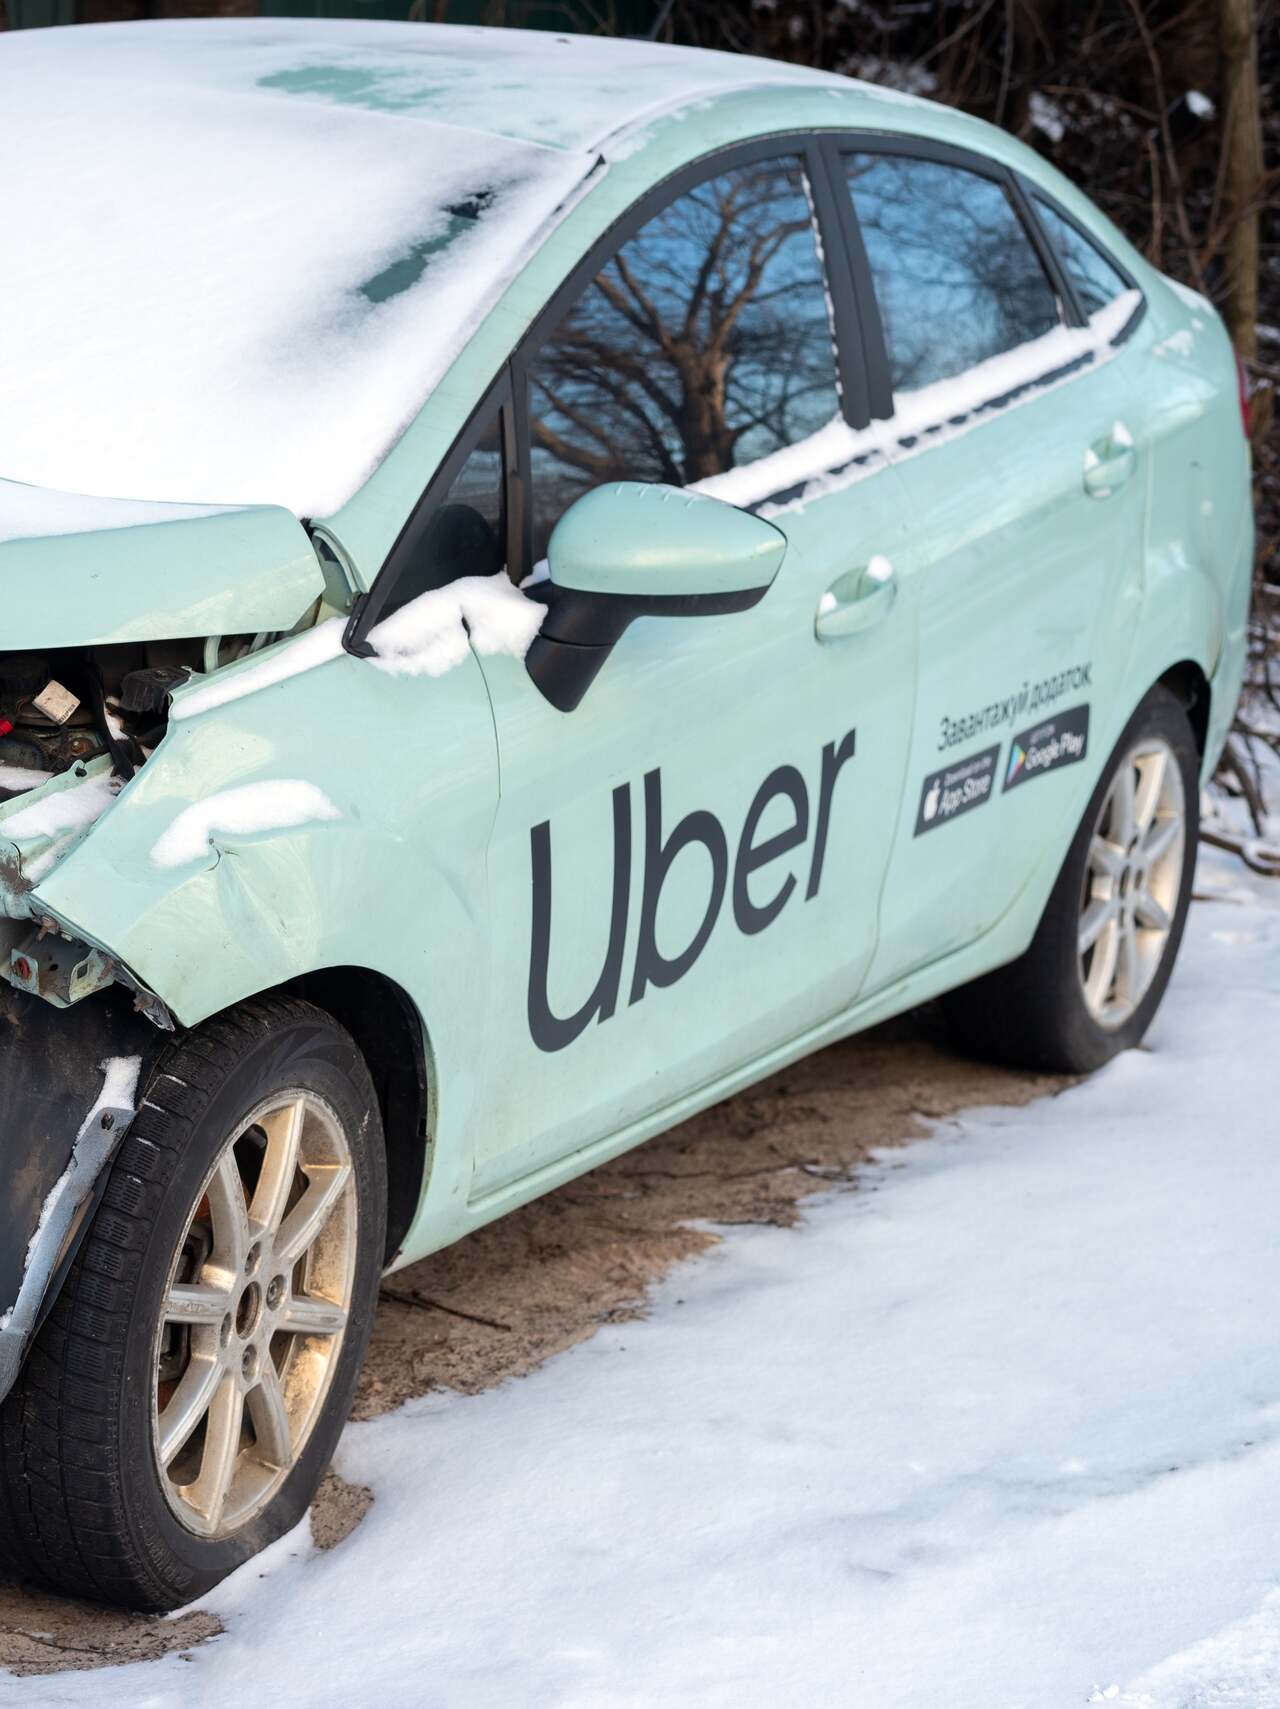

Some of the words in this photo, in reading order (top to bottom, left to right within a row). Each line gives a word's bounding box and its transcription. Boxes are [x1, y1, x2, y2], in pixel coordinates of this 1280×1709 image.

[937, 681, 1028, 751] Завантажуй
[1028, 663, 1092, 713] додаток
[1025, 737, 1060, 770] Google
[1060, 731, 1084, 757] Play
[962, 774, 991, 805] Store
[527, 728, 856, 1053] Uber
